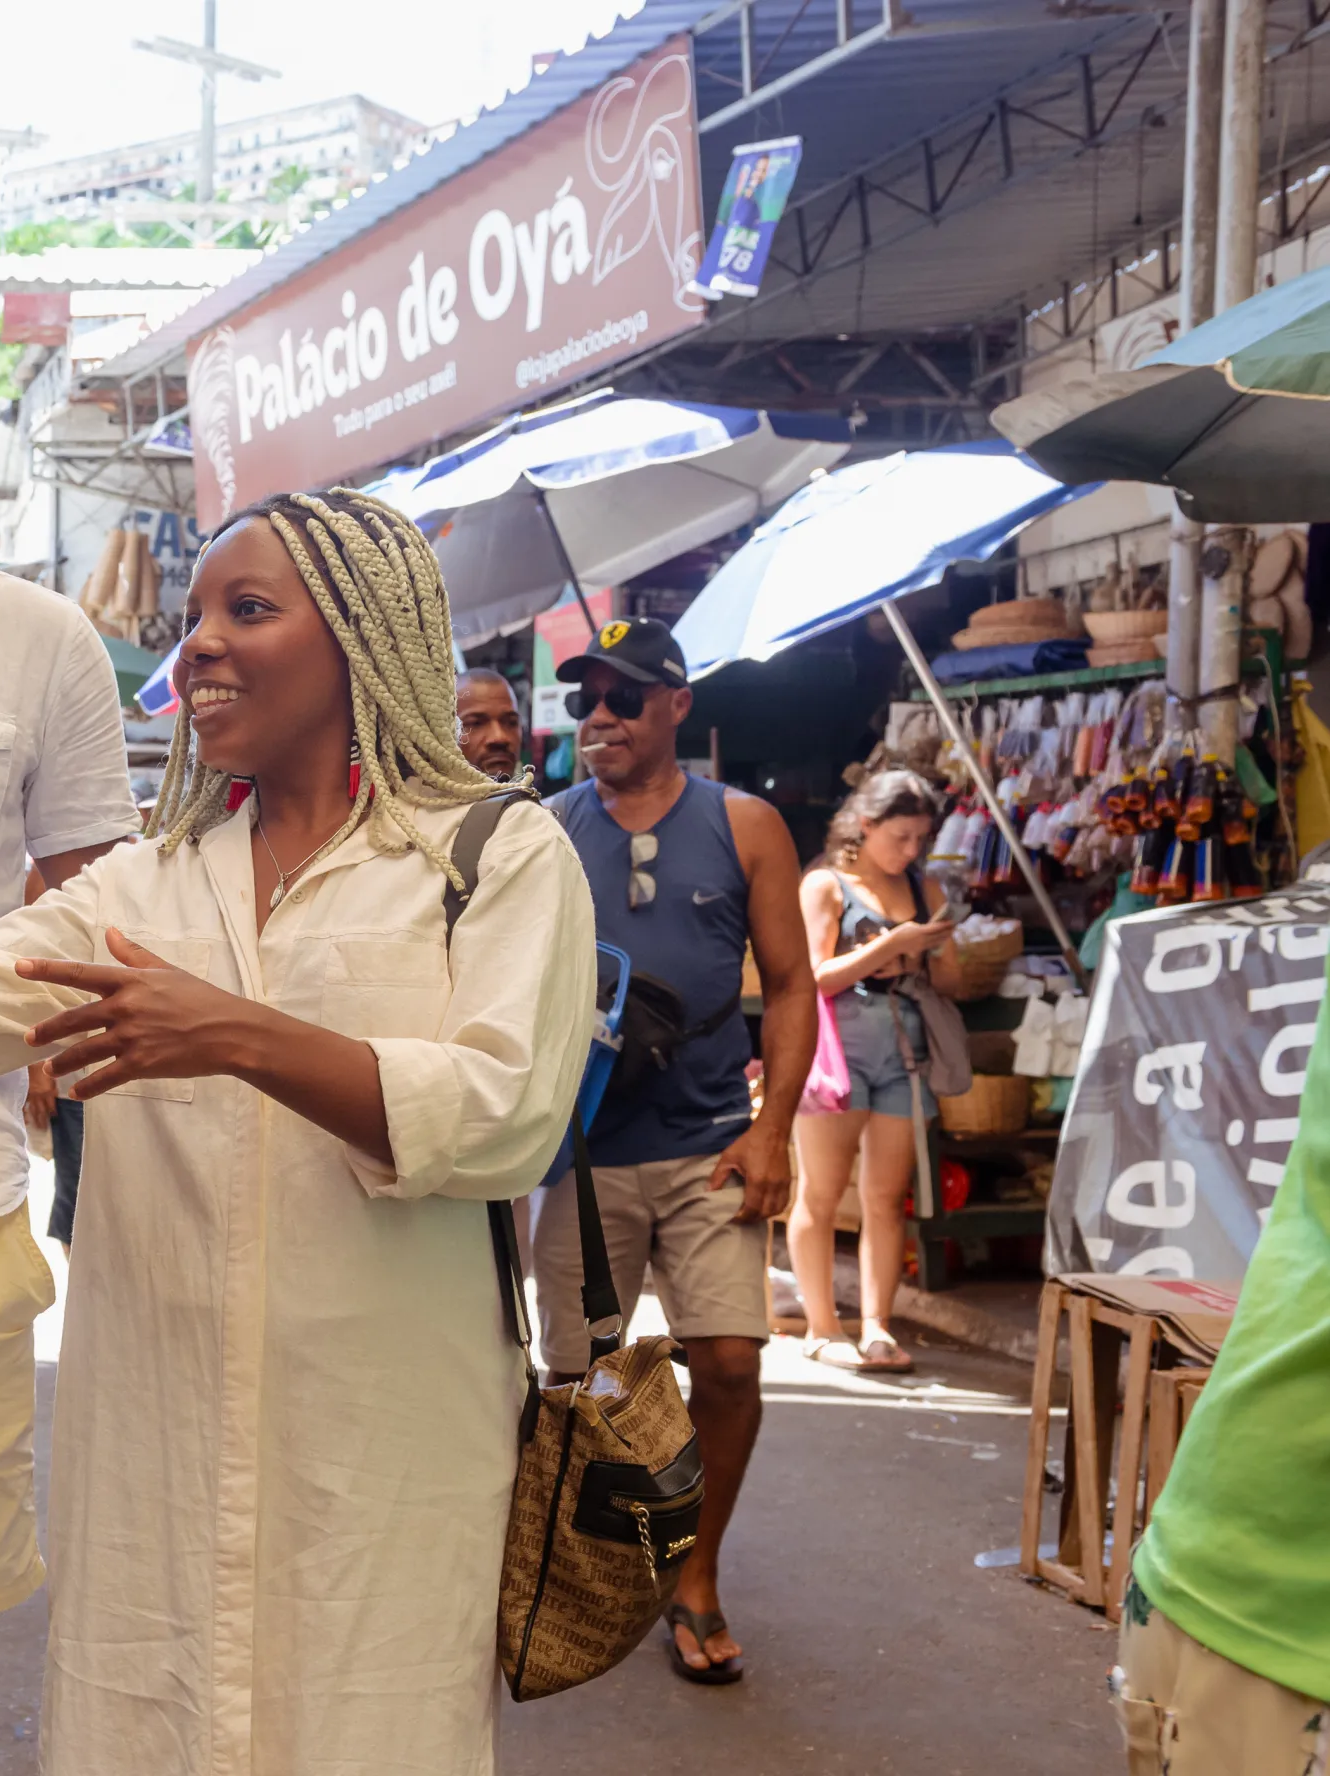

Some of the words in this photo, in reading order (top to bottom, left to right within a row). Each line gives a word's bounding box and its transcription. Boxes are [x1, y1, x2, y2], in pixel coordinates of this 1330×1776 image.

[234, 289, 388, 444] Palácio
[397, 251, 460, 362] de
[468, 176, 592, 332] Oyá
[1133, 1040, 1208, 1111] a
